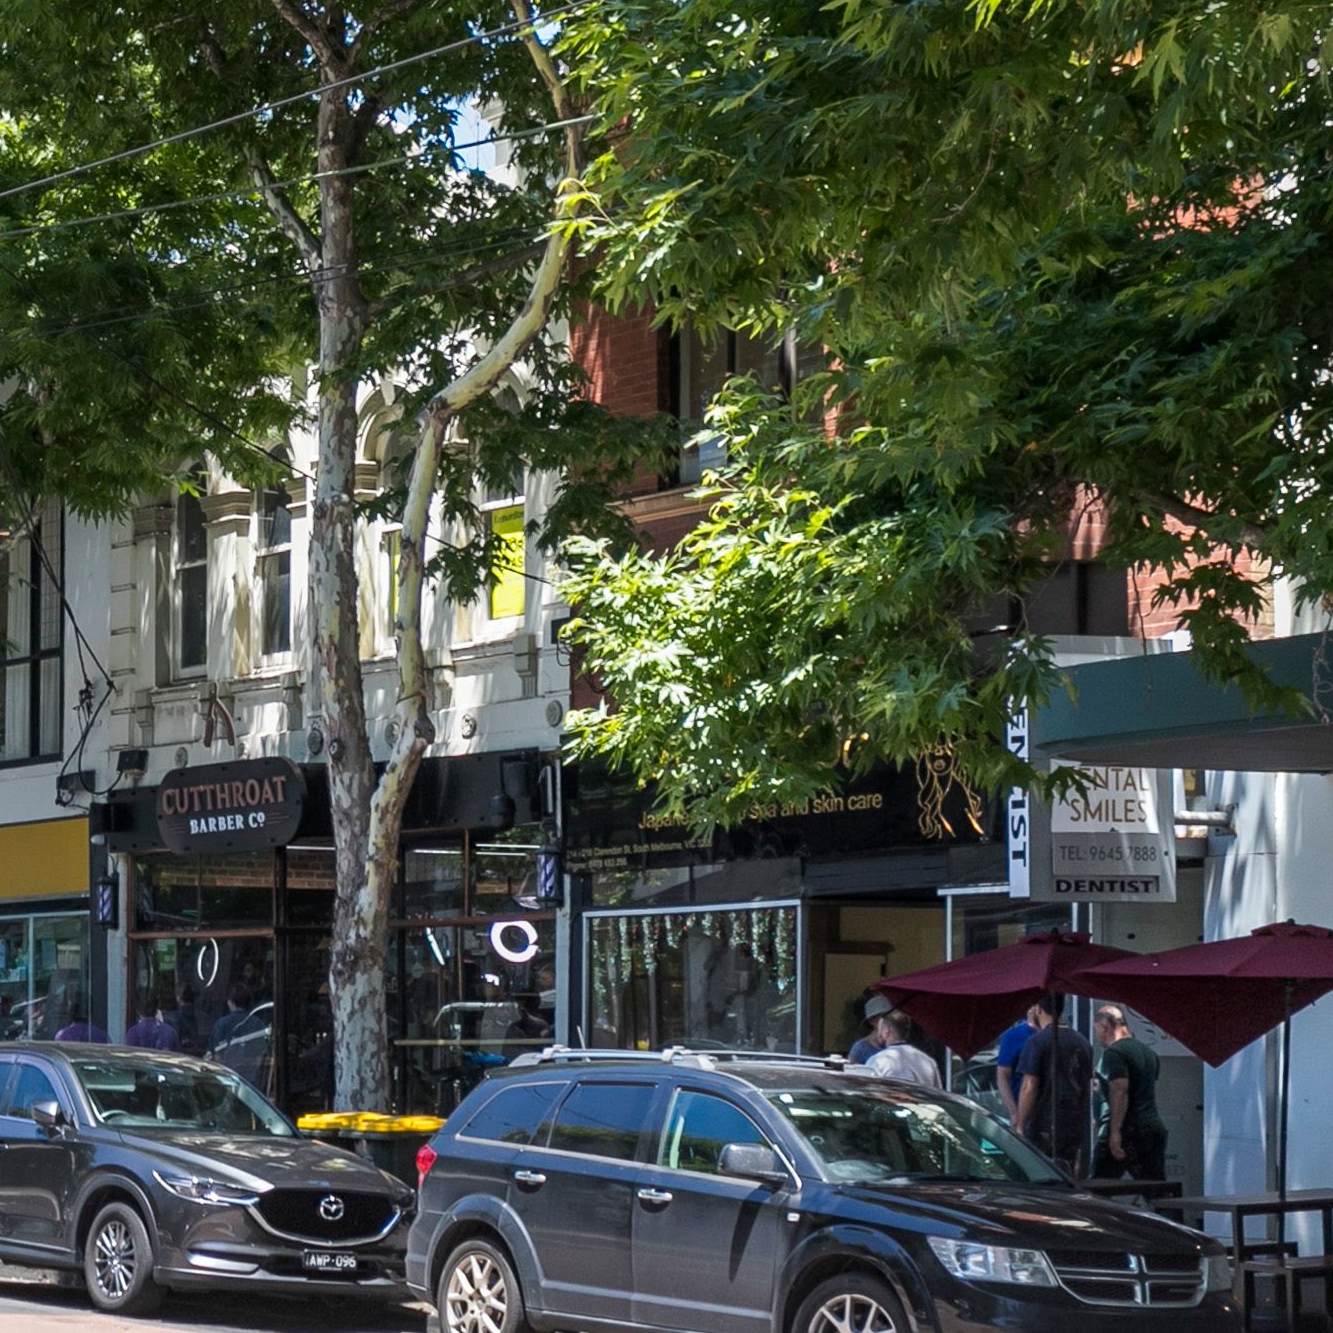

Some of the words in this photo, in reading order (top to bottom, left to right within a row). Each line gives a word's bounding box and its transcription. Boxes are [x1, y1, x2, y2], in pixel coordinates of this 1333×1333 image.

[161, 775, 287, 815] CUTTHROAT
[1011, 704, 1027, 868] ENIST
[813, 794, 844, 814] skin
[847, 793, 883, 810] care
[1070, 798, 1148, 822] SMILES
[190, 815, 244, 834] BARBER
[1089, 846, 1123, 861] 9645
[1055, 878, 1154, 893] DENTIST
